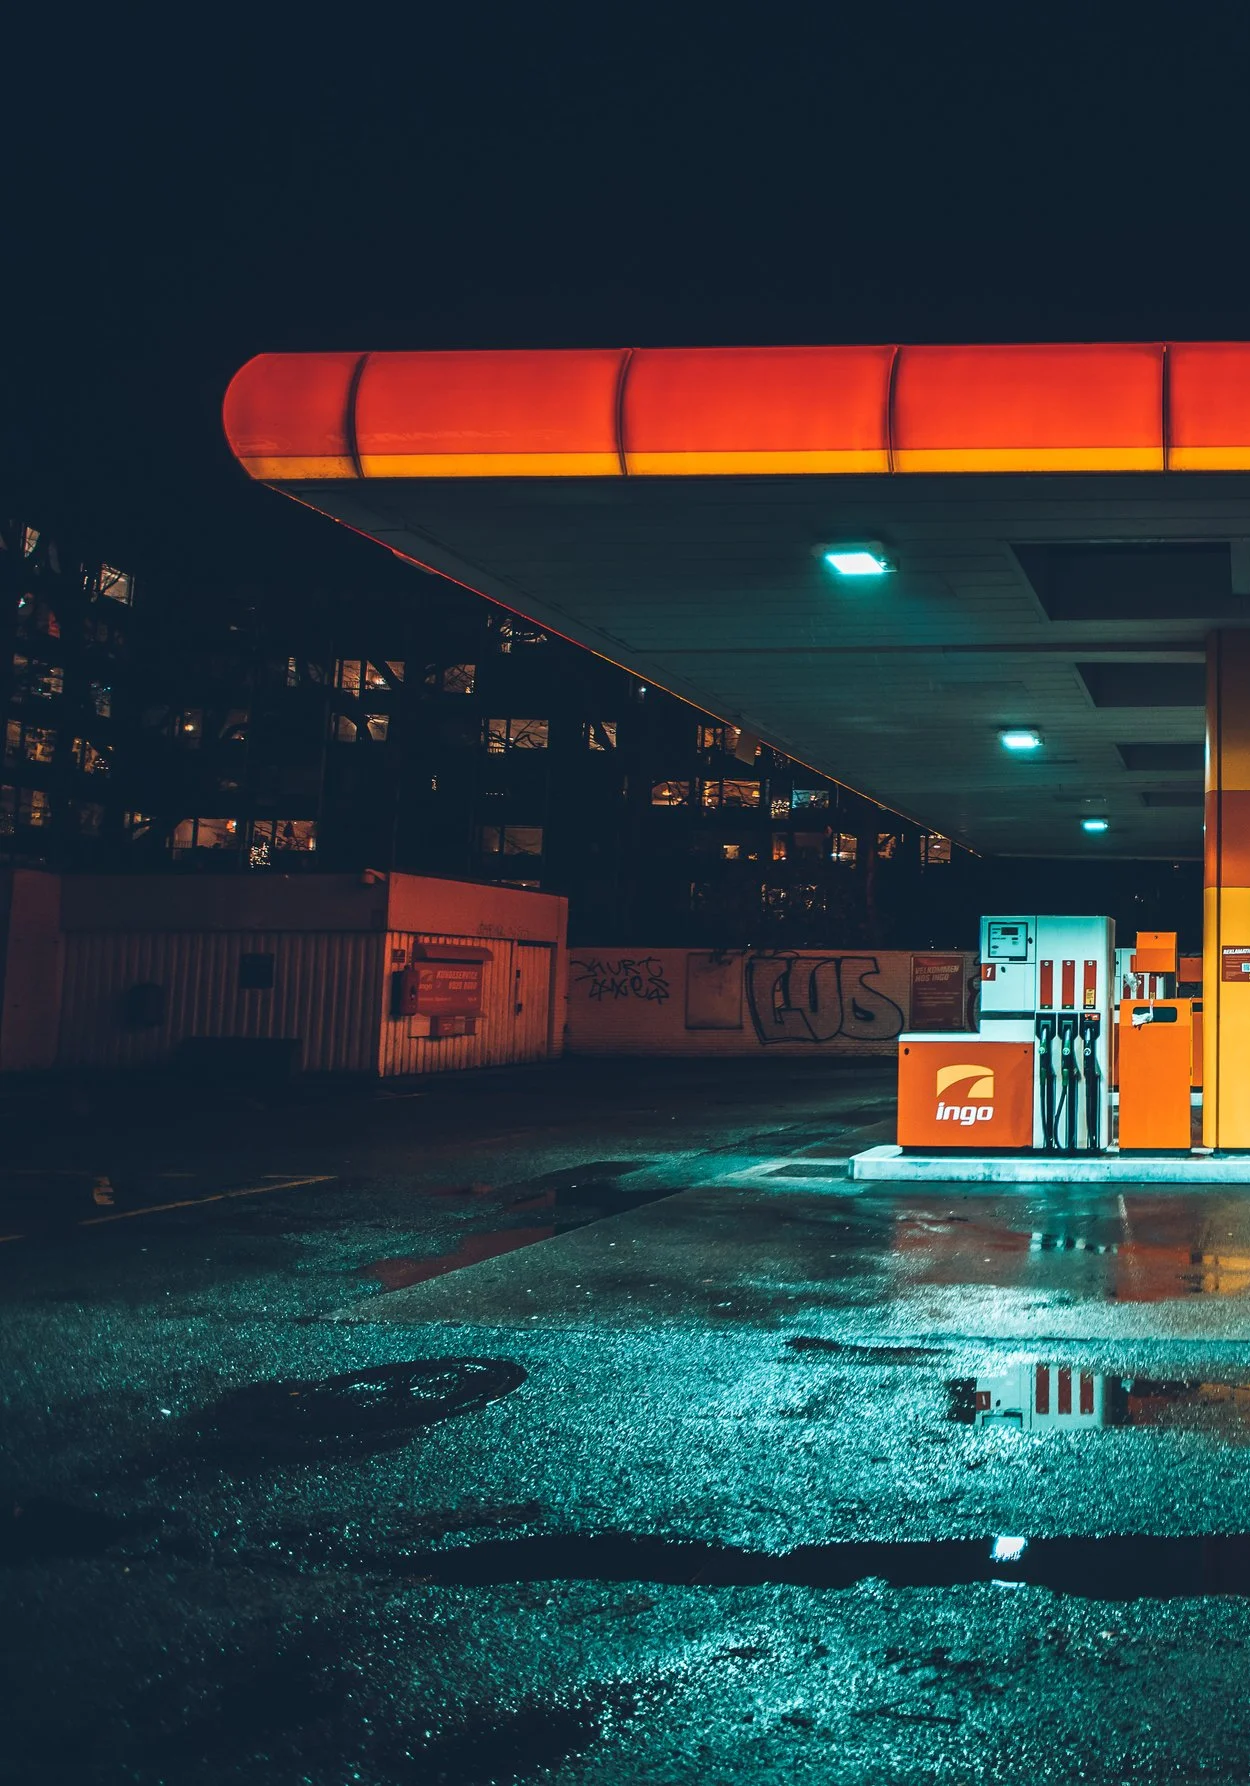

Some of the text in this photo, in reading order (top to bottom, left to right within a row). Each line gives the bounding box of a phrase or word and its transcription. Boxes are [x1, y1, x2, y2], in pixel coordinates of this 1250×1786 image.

[915, 965, 959, 975] VELKOMMEN
[986, 967, 992, 978] 1
[915, 973, 950, 982] HOS INGO
[936, 1101, 994, 1126] ingo
